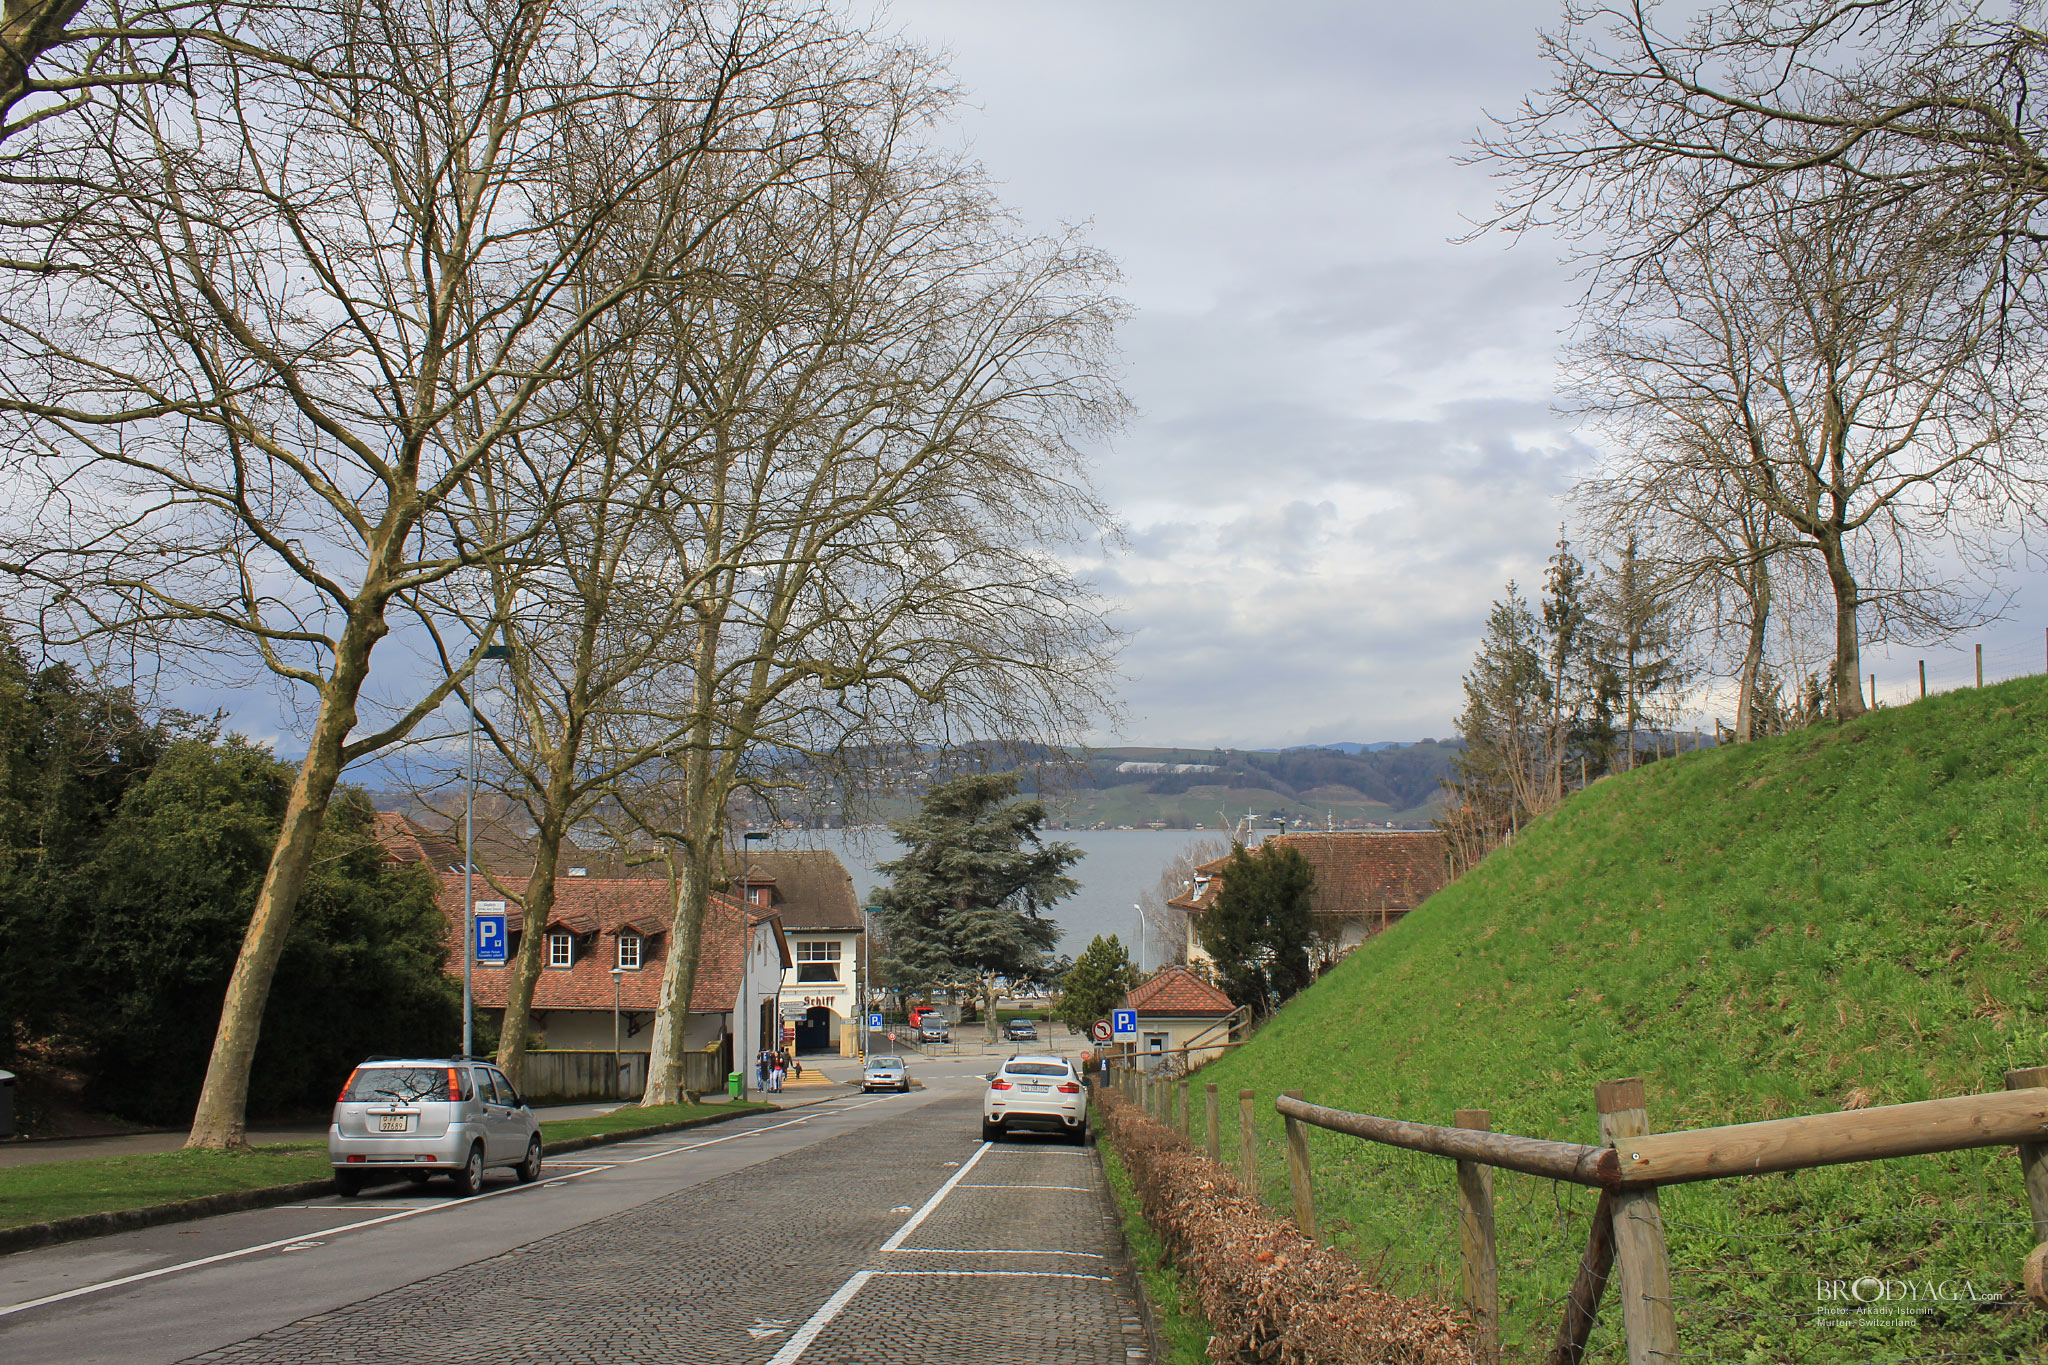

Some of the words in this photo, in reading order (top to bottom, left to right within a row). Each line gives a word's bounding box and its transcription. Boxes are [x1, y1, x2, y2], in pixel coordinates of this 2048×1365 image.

[480, 921, 497, 948] P
[804, 995, 835, 1006] Schiff
[1118, 1013, 1129, 1030] P
[383, 1122, 403, 1130] 97689
